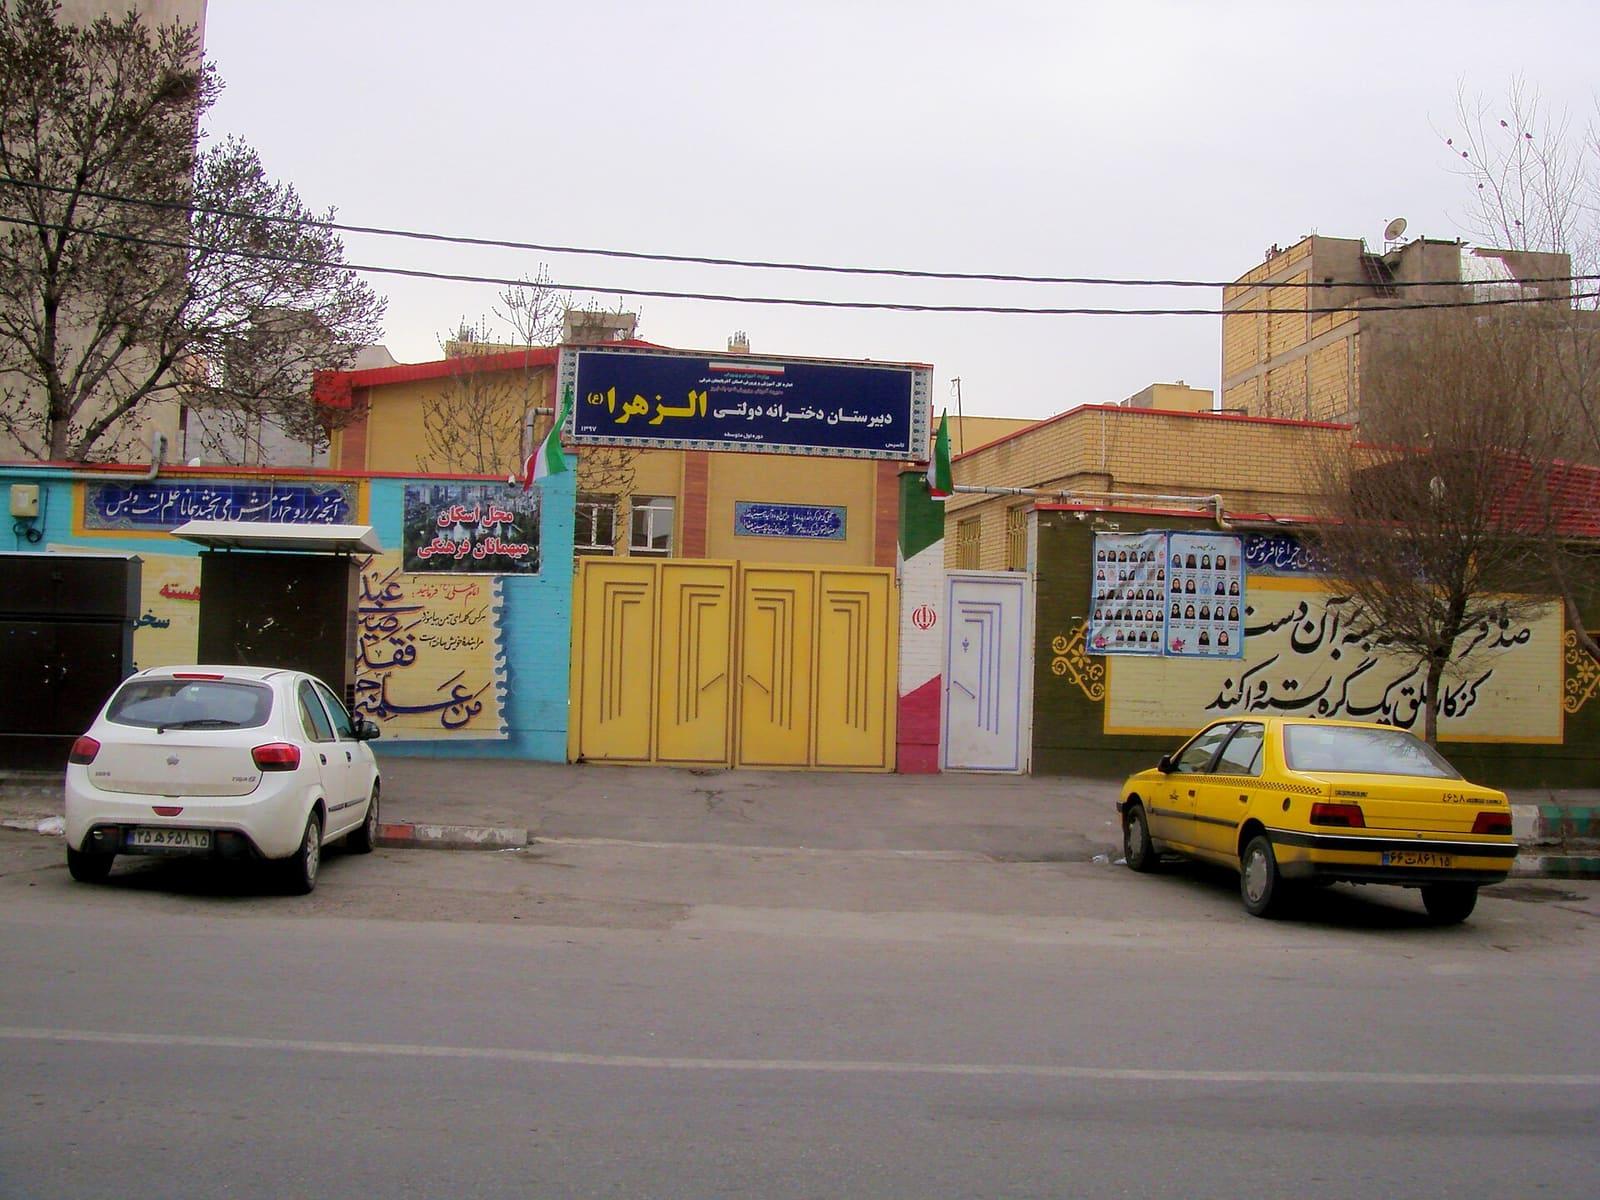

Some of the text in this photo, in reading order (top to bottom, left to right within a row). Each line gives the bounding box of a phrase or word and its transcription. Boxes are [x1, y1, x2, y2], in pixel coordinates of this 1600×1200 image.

[607, 386, 708, 425] الزهرا
[713, 401, 764, 421] دولتی
[766, 404, 825, 423] دخترانه
[827, 407, 893, 427] دبیرستان
[131, 492, 164, 514] است
[161, 490, 180, 523] علم
[437, 503, 514, 528] محل اسکان
[417, 537, 529, 560] میهمانان فرهنگی
[441, 700, 482, 730] من
